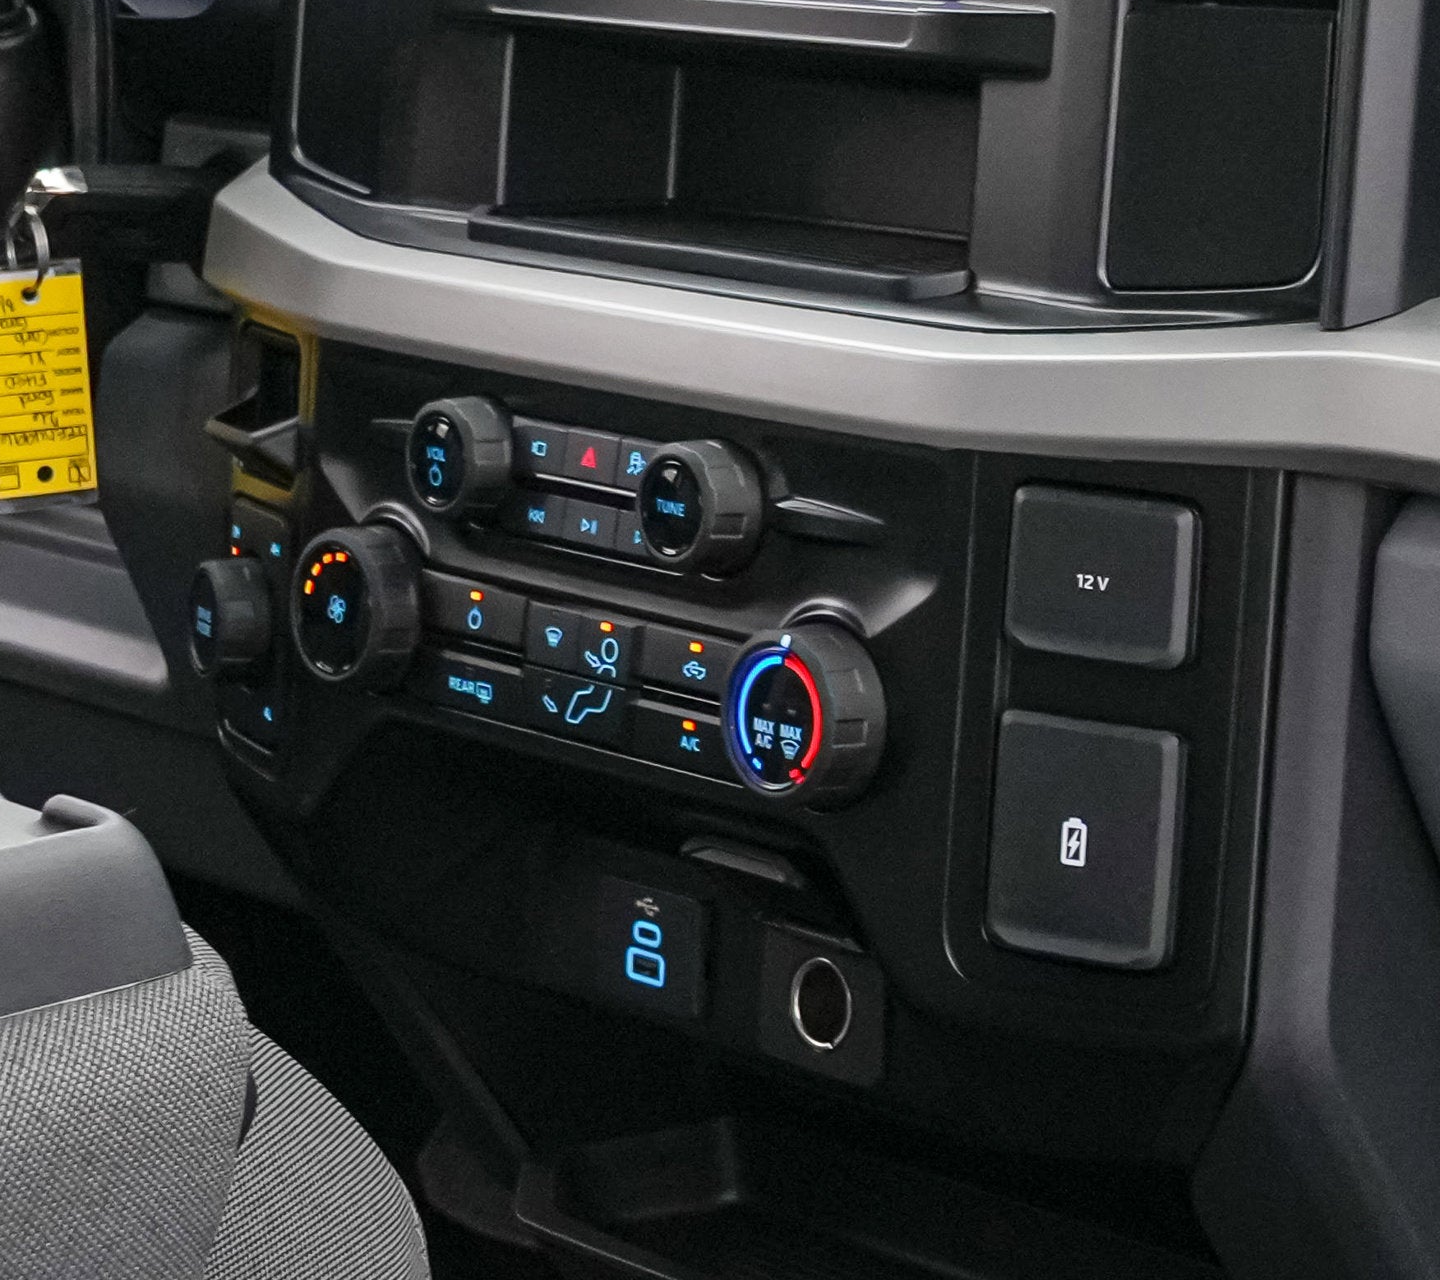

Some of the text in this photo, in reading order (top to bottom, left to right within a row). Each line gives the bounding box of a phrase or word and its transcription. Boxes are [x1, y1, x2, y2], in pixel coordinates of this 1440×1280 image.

[656, 498, 685, 518] TUNE
[1076, 573, 1110, 591] 12 V
[448, 675, 475, 695] REAR
[753, 716, 775, 736] MAX
[779, 723, 803, 742] MAX
[679, 734, 700, 753] A/C
